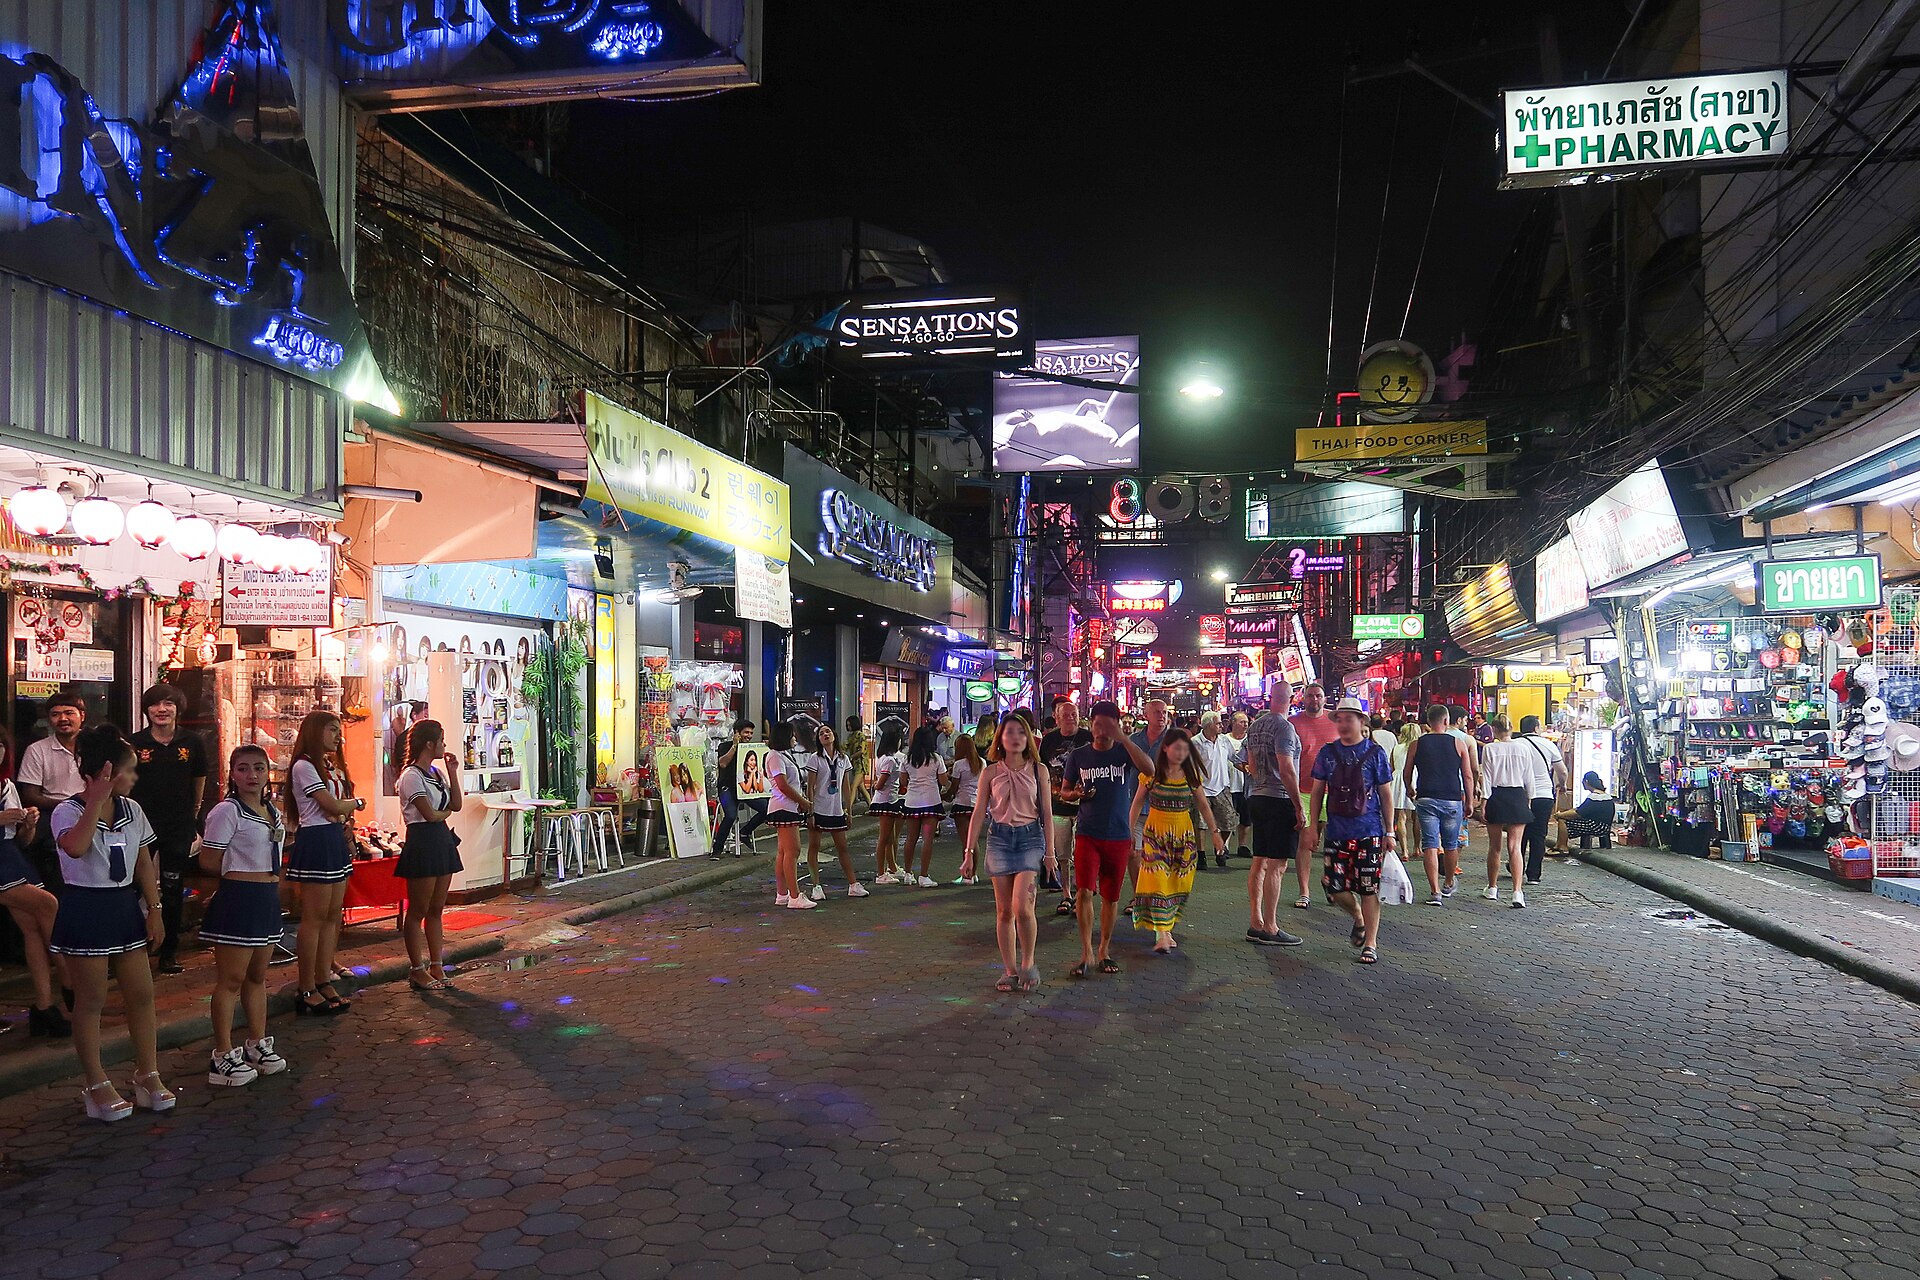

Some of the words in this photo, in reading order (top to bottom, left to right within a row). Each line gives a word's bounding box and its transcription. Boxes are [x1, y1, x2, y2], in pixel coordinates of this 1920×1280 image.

[1516, 86, 1682, 132] พัทยาเภสัช
[1690, 81, 1781, 122] (สาขา)
[1555, 119, 1781, 166] PHARMACY
[840, 308, 1019, 347] SENSATIONS
[901, 332, 955, 344] A-GO-GO
[1312, 439, 1349, 450] THAI
[1354, 436, 1398, 448] FOOD
[1403, 432, 1470, 446] CORNER
[593, 418, 651, 477] Nui's
[701, 467, 710, 500] 2
[727, 471, 779, 515] 런웨이
[1109, 475, 1231, 524] 808
[668, 496, 709, 521] RUNWAY
[1629, 533, 1661, 560] Walking
[1656, 519, 1685, 549] Street
[247, 588, 259, 597] ENTER
[1225, 582, 1293, 603] FAHRENHEIT
[1774, 565, 1865, 602] ขายยา
[1232, 620, 1271, 633] MIAMI
[1690, 623, 1727, 634] OPEN
[78, 660, 107, 672] 1669
[598, 598, 612, 750] RUNWA
[781, 702, 820, 710] SENSATIONS
[657, 748, 702, 761] イイ女いるよ
